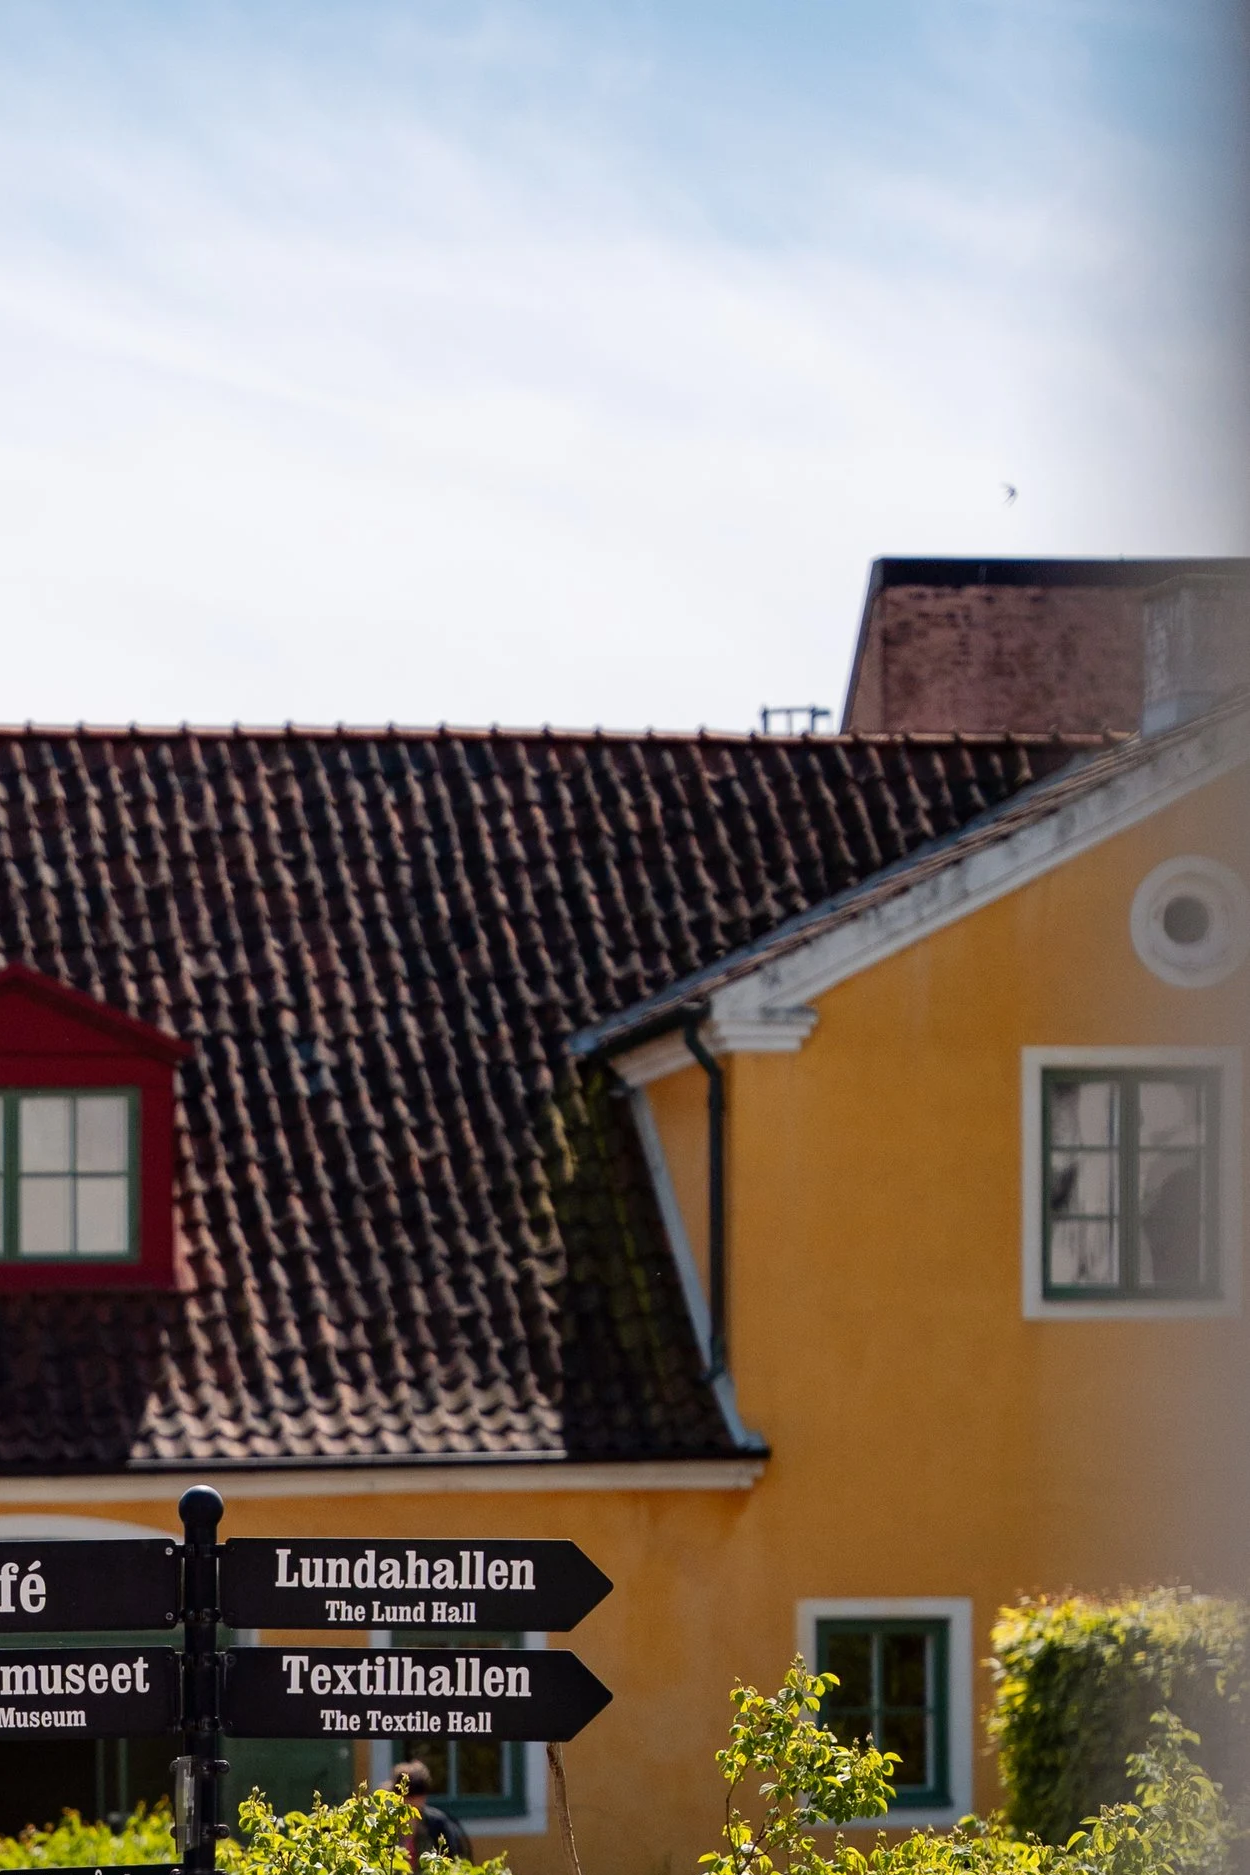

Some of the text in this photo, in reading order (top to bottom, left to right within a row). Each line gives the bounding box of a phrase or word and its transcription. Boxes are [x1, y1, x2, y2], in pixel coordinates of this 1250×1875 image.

[275, 1548, 535, 1591] Lundahallen
[326, 1600, 476, 1623] The Lund Hall
[282, 1655, 532, 1697] Textilhallen
[321, 1710, 492, 1733] The Textile Hall
